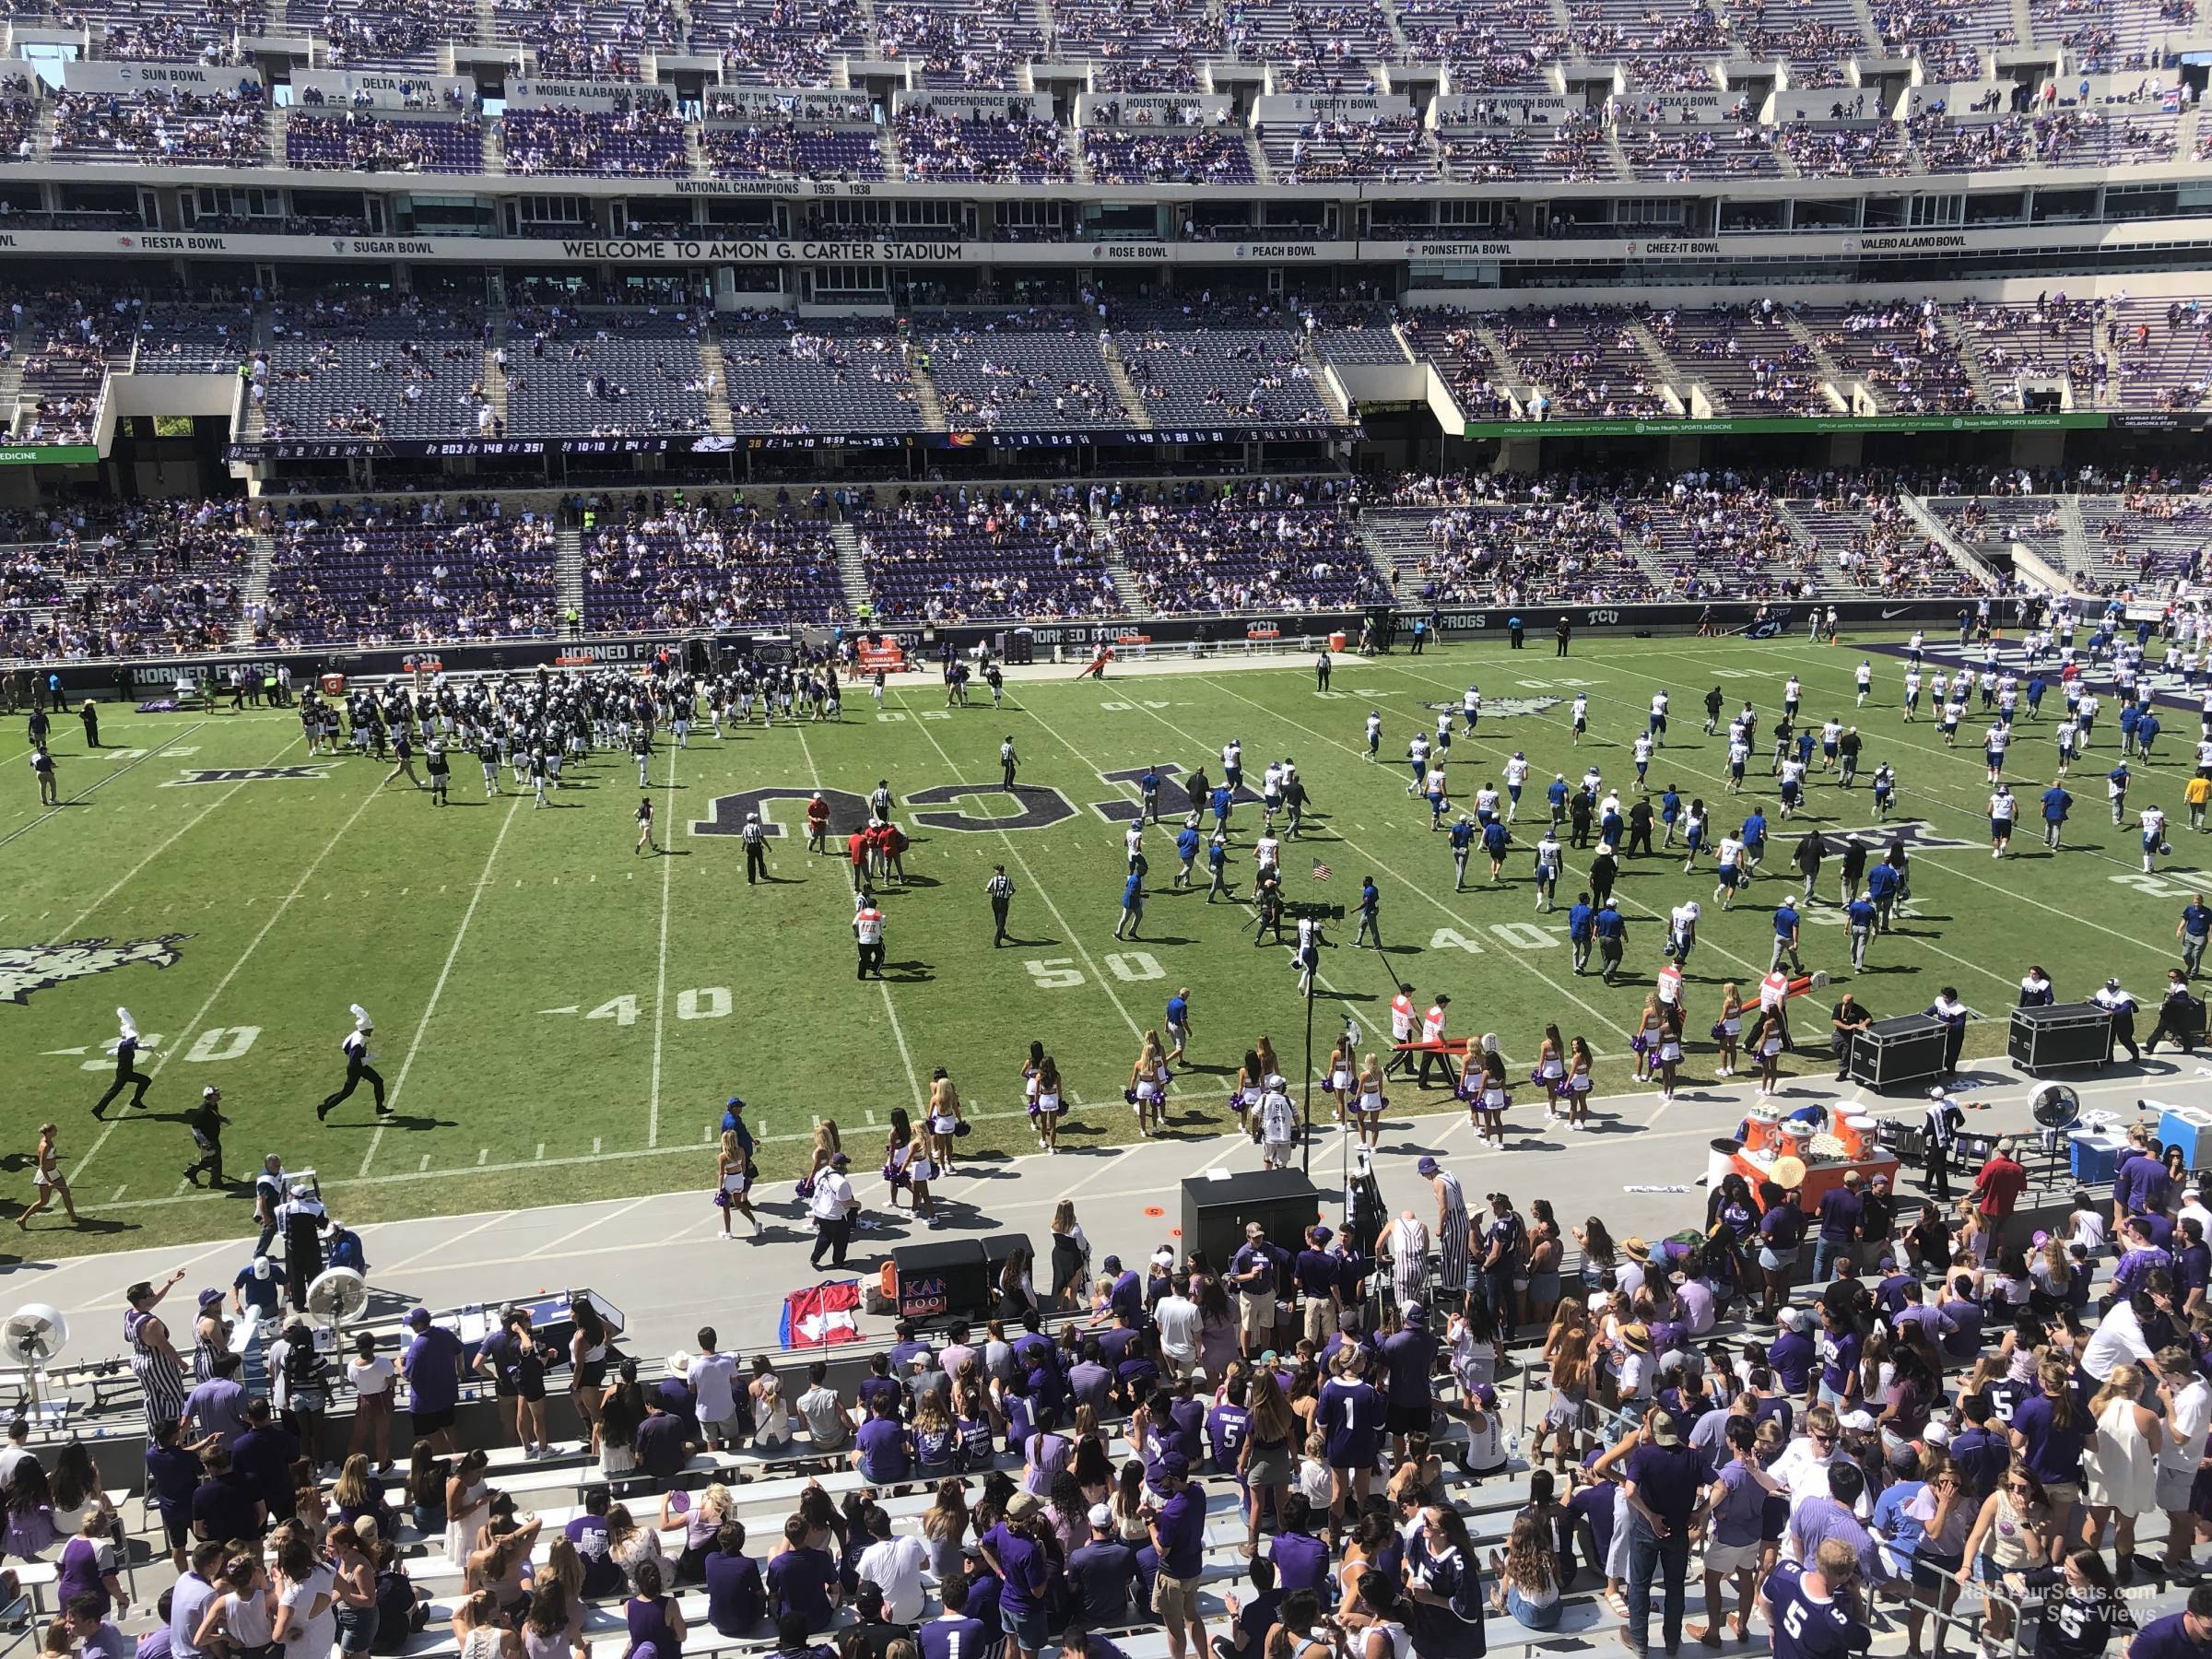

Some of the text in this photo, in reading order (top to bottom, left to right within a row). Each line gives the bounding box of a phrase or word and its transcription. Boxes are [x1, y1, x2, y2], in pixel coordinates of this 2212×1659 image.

[141, 68, 206, 83] SUN BOWL
[361, 76, 396, 89] DELTA
[535, 84, 577, 98] MOBILE
[579, 86, 632, 99] ALABAMA
[710, 92, 771, 102] HOME OF THE
[805, 94, 867, 105] HORNED FROGS
[932, 96, 1005, 108] INDEPENDENCE
[1126, 99, 1203, 110] HOUSTON BOWL
[1310, 99, 1379, 110] LIBERTY BOWL
[1538, 98, 1566, 109] BOWL
[1658, 96, 1719, 108] TEXAS BOWL
[675, 182, 870, 195] NATIONAL CHAMPIONS 1935 1938
[141, 236, 227, 250] FIESTA BOWL
[353, 241, 434, 254] SUGAR BOWL
[1646, 242, 1720, 253] CHEEZ-IT BOWL
[1861, 236, 1966, 249] VALERO ALAMO BOWL
[562, 241, 961, 259] WELCOME TO AMON G. CARTER STADIUM
[1109, 246, 1168, 257] ROSE BOWL
[1253, 245, 1317, 257] PEACH BOWL
[1422, 243, 1512, 255] POINSETTIA BOWL
[993, 436, 1000, 445] 2
[1140, 433, 1154, 442] 49
[1176, 433, 1189, 442] 28
[1212, 432, 1223, 441] 21
[1252, 430, 1258, 440] 5
[1280, 430, 1287, 440] 4
[441, 442, 464, 454] 203
[484, 442, 503, 454] 148
[524, 442, 544, 453] 351
[577, 441, 606, 452] 10/10
[625, 441, 640, 451] 24
[748, 439, 762, 448] 38
[805, 438, 815, 448] 10
[871, 438, 884, 447] 35
[296, 446, 304, 456] 2
[329, 446, 337, 455] 2
[366, 445, 373, 455] 4
[0, 452, 37, 460] EDICINE
[1441, 615, 1486, 629] FROGS
[1588, 610, 1619, 625] TCU
[561, 645, 629, 661] HORNED
[133, 666, 208, 684] HORNED
[328, 680, 337, 689] G
[2084, 701, 2090, 710] 9
[1993, 735, 2006, 744] 58
[429, 754, 441, 764] 90
[1510, 765, 1522, 775] 82
[687, 762, 1266, 839] TCU
[1480, 797, 1493, 807] 29
[1992, 797, 2012, 808] 72
[2144, 817, 2159, 827] 25
[1541, 848, 1555, 859] 14
[1726, 844, 1734, 855] 7
[1674, 918, 1688, 931] 13
[1430, 922, 1561, 953] 40
[1022, 951, 1167, 989] 50
[2024, 985, 2039, 994] TCU
[586, 986, 734, 1026] 40
[2101, 1000, 2115, 1009] TCU
[1937, 1007, 1950, 1018] TCU
[1766, 1128, 1776, 1140] G
[1862, 1135, 1872, 1147] G
[1798, 1143, 1808, 1155] G
[1823, 1339, 1839, 1360] TCU
[1991, 1391, 2015, 1421] 5
[1023, 1398, 1036, 1427] 1
[1343, 1397, 1354, 1430] 1
[1223, 1424, 1239, 1448] 5
[1453, 1554, 1465, 1571] 5
[1783, 1600, 1808, 1640] 5
[1831, 1606, 1848, 1627] 5
[947, 1630, 960, 1659] 1
